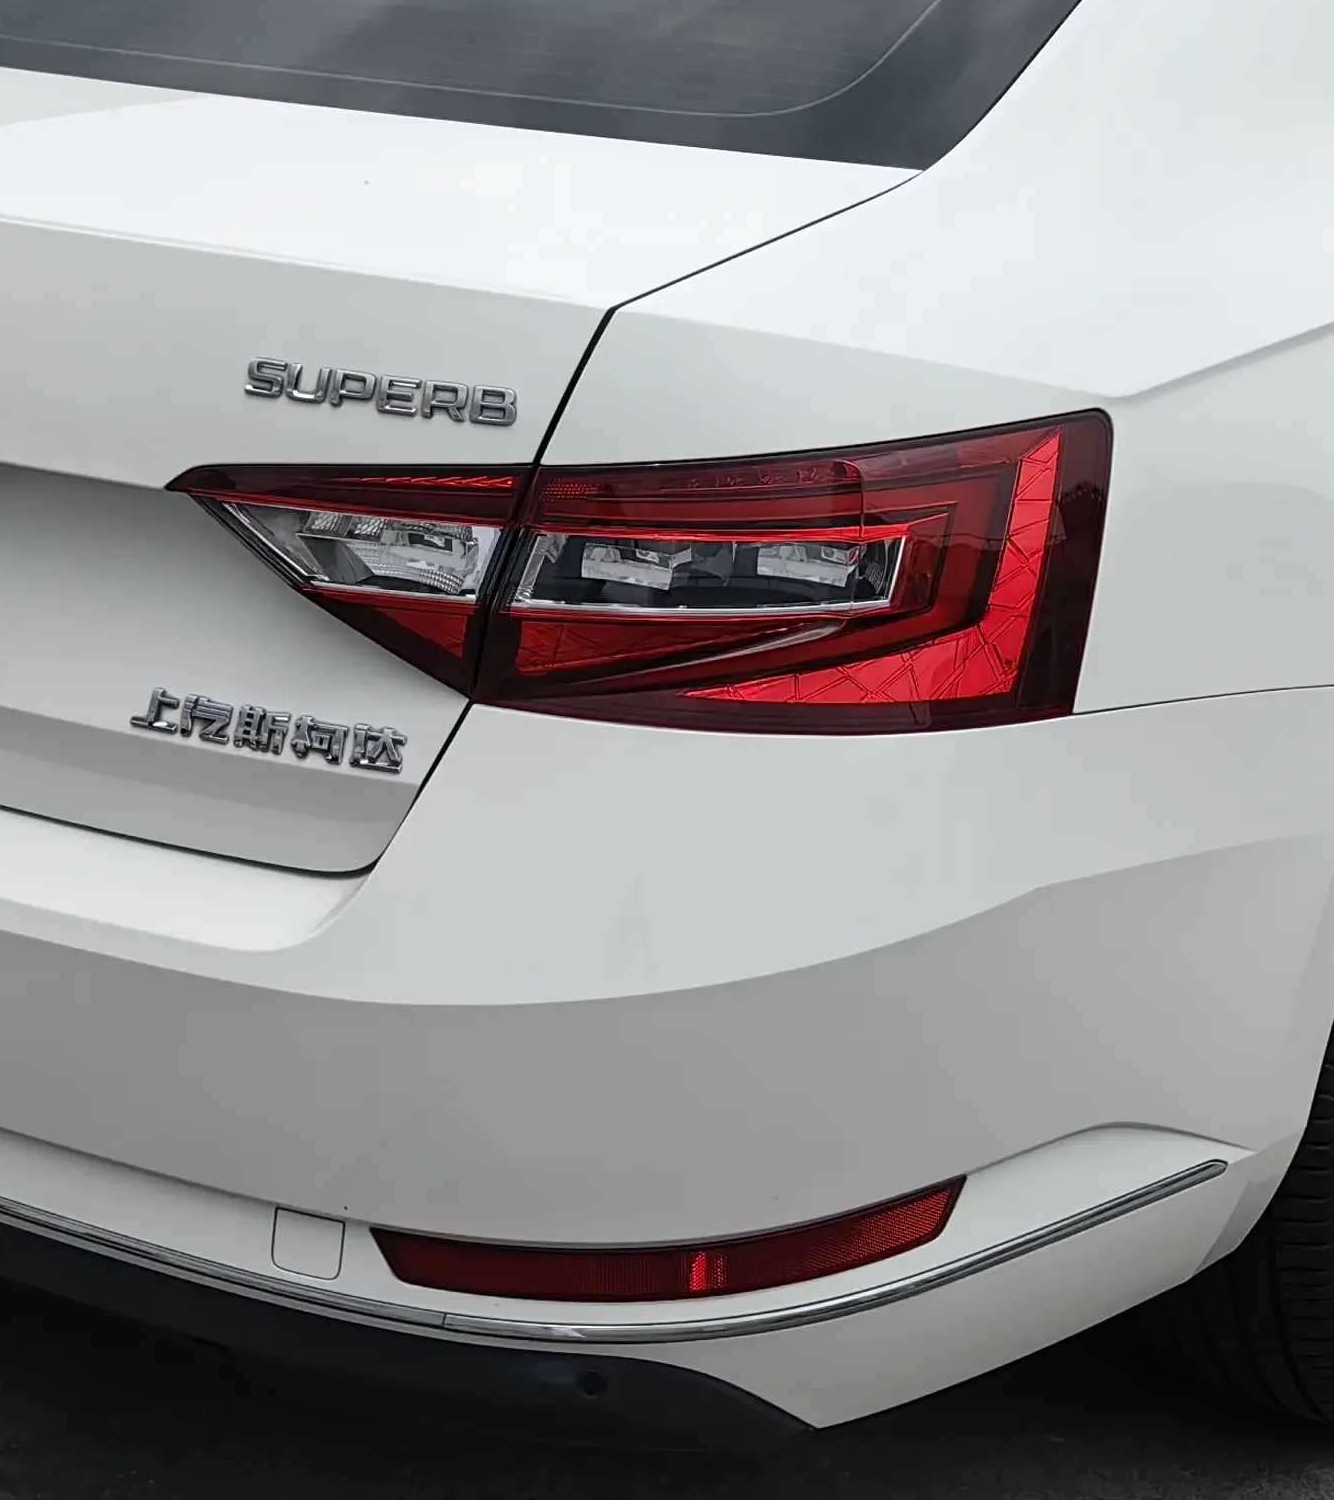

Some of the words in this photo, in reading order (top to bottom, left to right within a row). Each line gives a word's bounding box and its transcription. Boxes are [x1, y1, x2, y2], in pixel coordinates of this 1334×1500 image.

[244, 357, 517, 426] SUPERB
[130, 687, 407, 774] 上汽斯柯达
